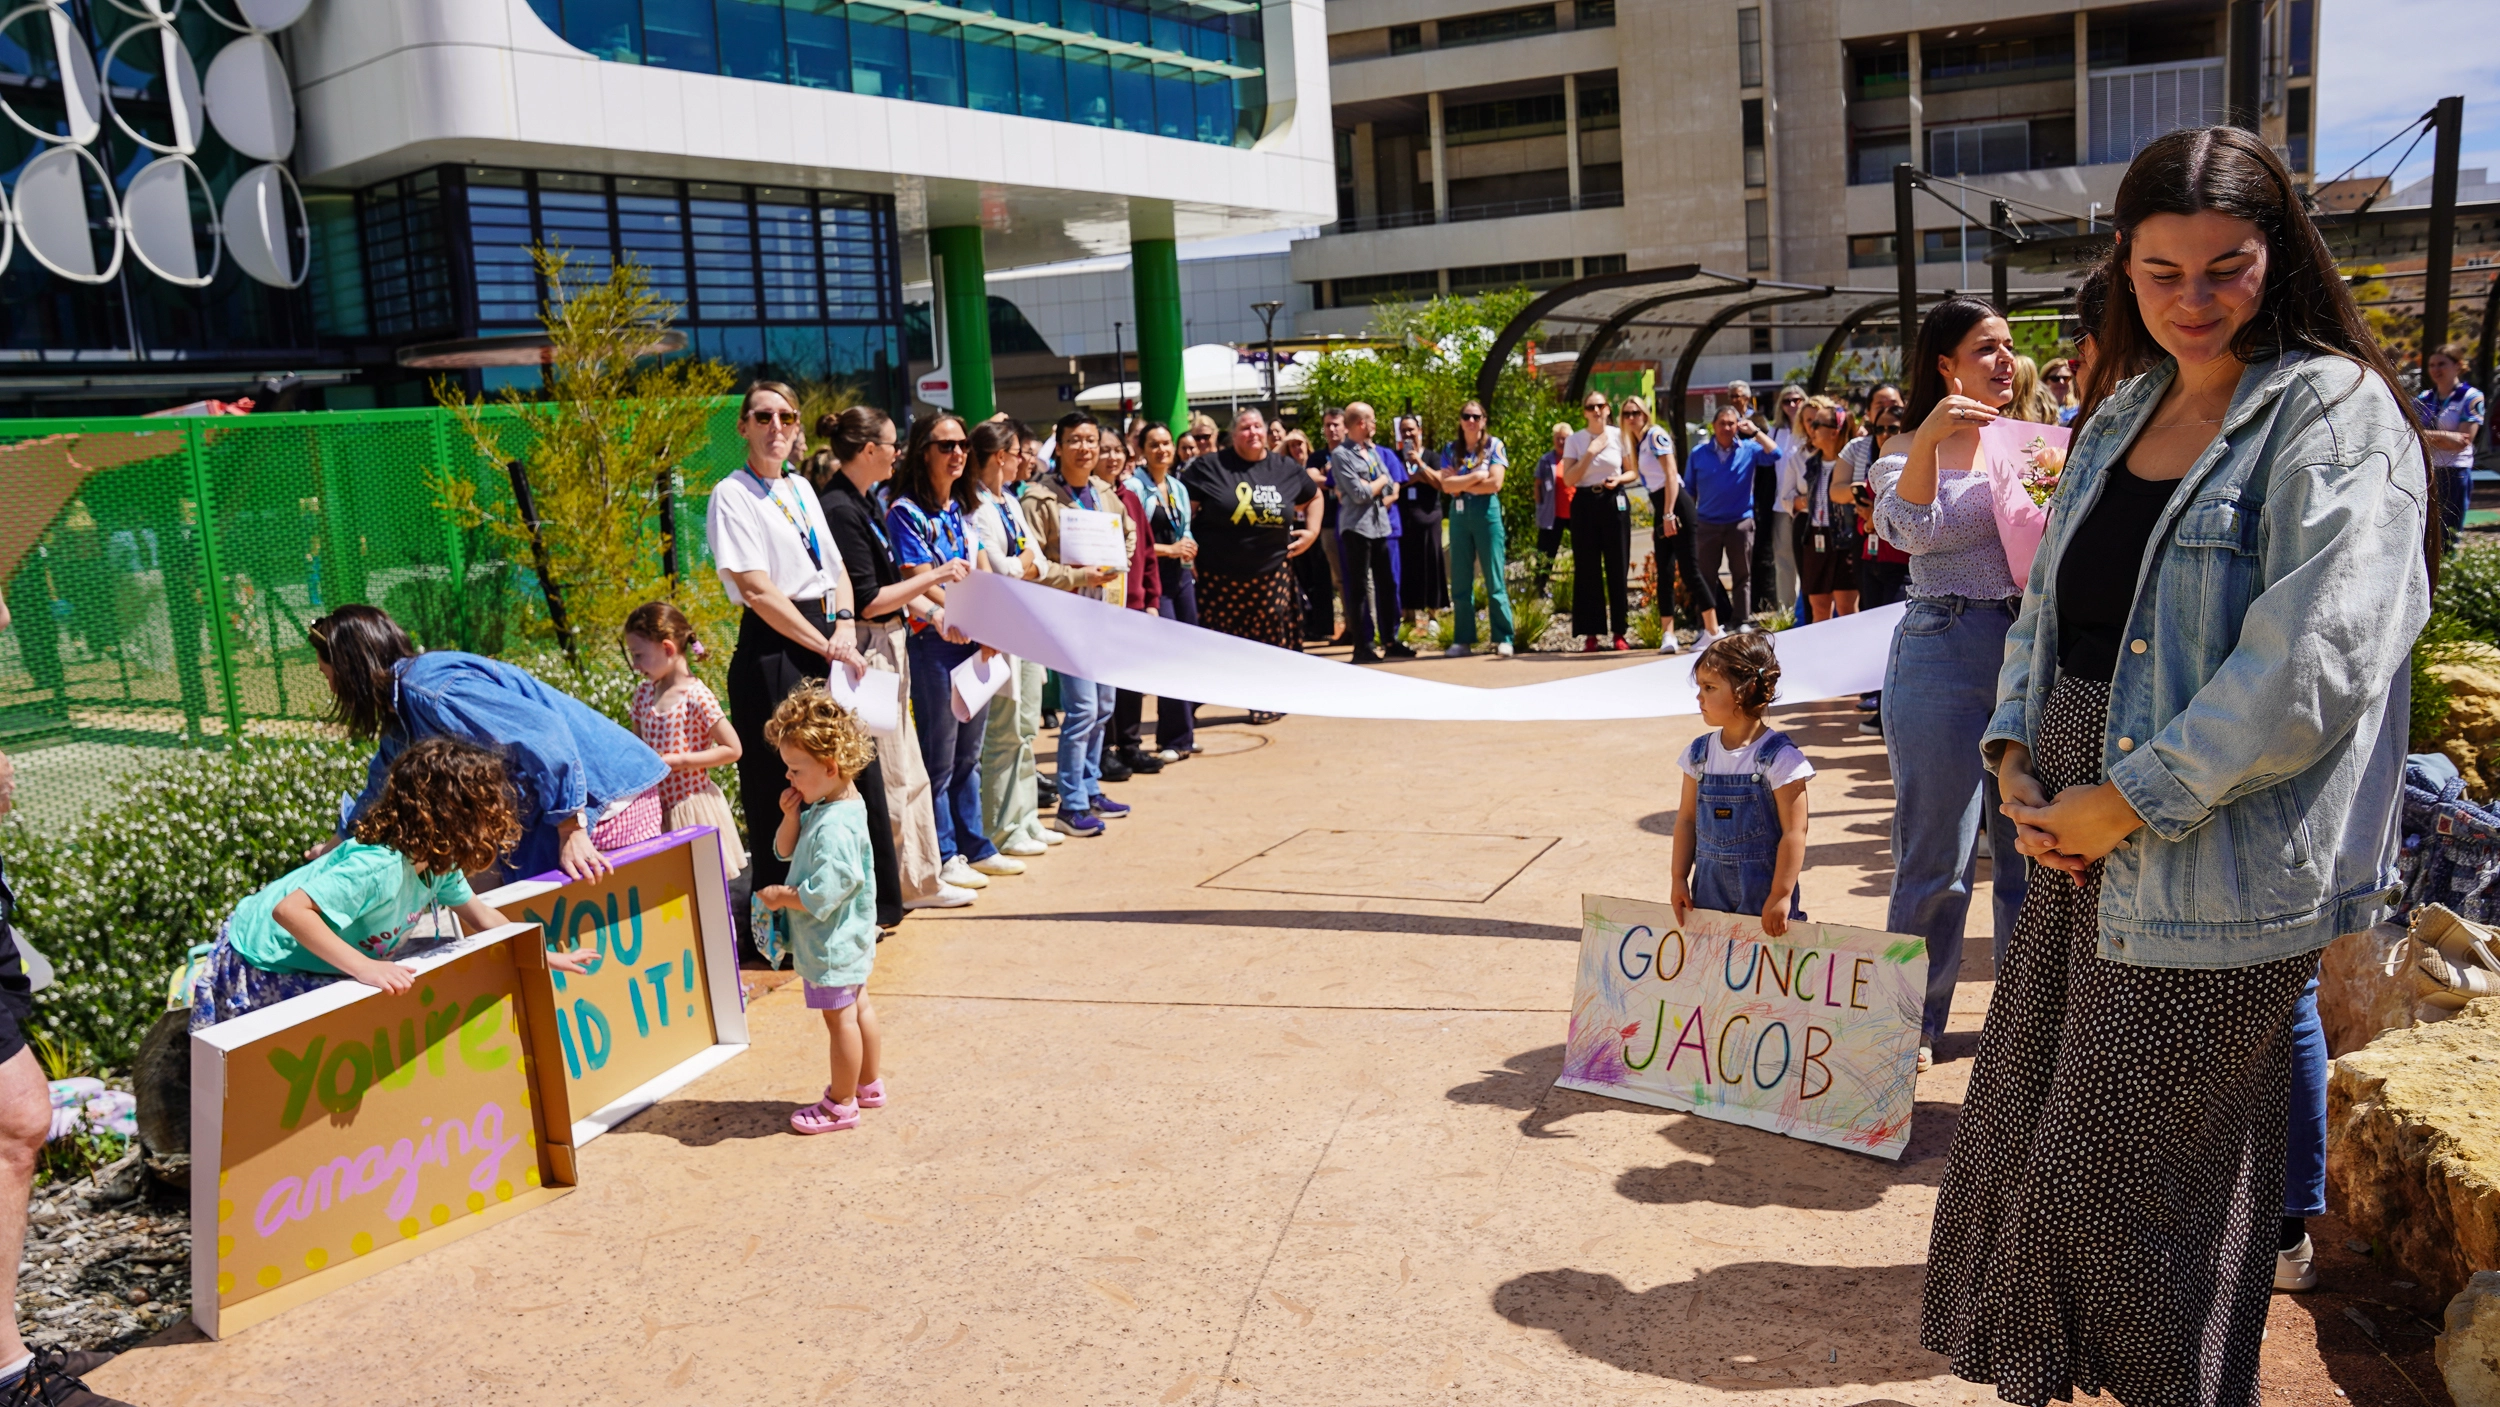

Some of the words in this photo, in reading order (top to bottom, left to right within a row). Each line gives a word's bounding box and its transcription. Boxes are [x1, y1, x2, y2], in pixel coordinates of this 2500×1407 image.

[1253, 490, 1282, 503] GOLD
[522, 885, 643, 993] YOU
[1618, 925, 1686, 981] GO
[1724, 938, 1875, 1011] UNCLE
[628, 948, 694, 1038] IT!
[1623, 999, 1833, 1101] JACOB
[254, 1101, 520, 1238] amazing
